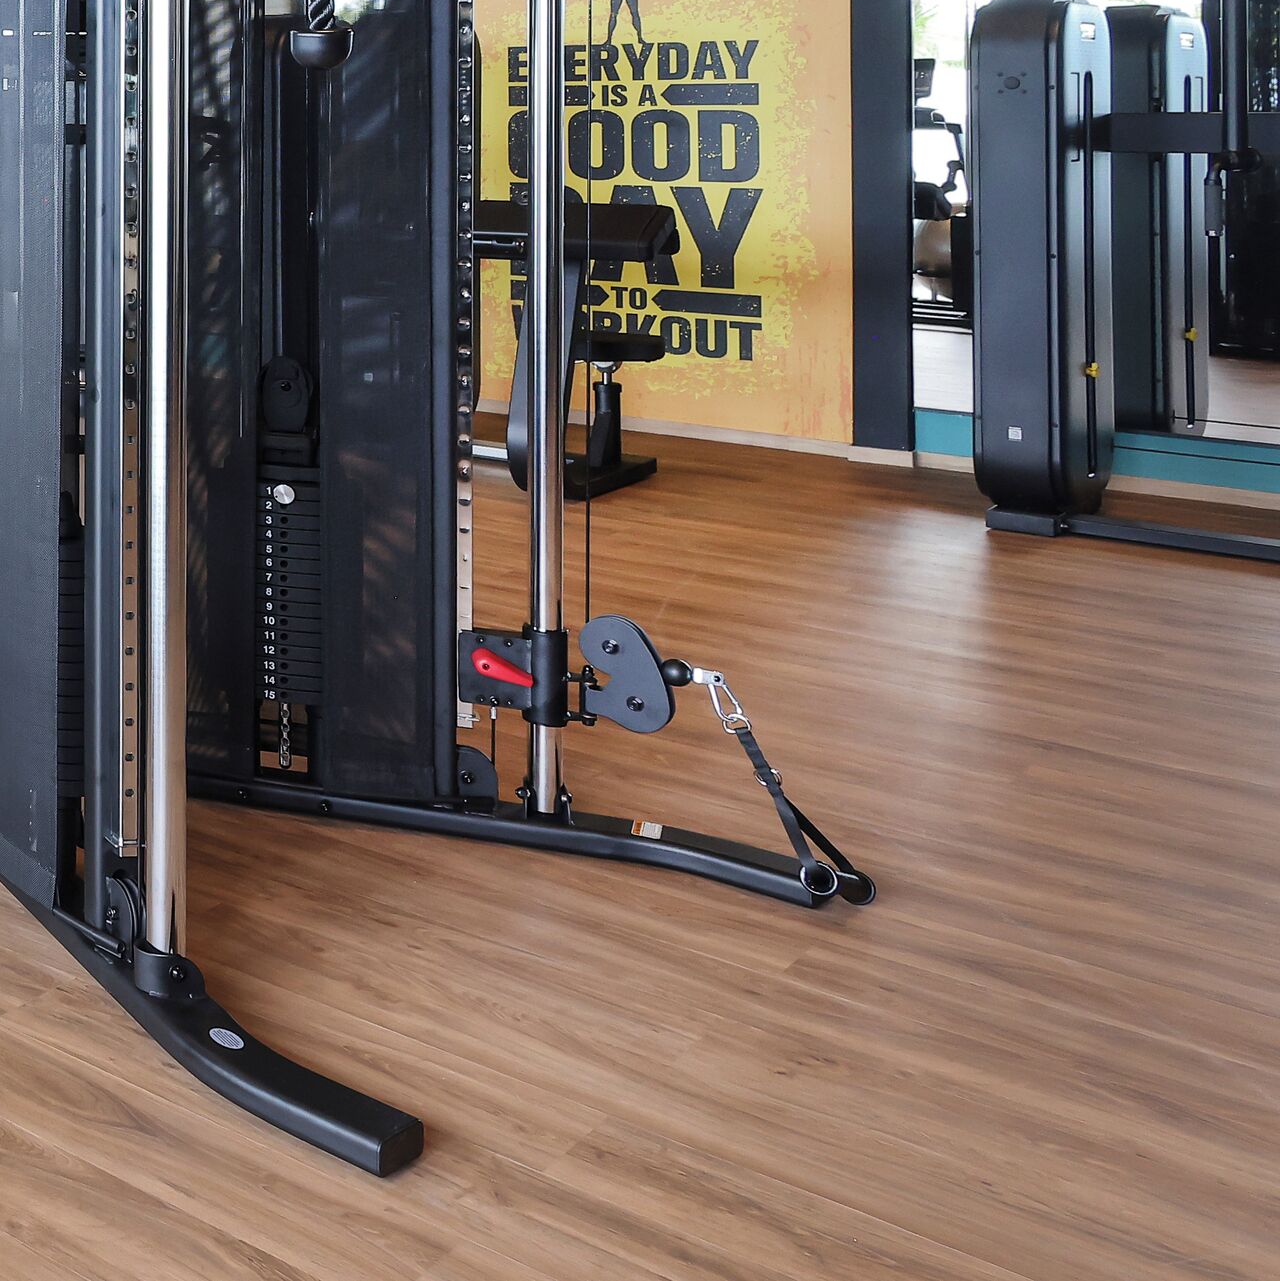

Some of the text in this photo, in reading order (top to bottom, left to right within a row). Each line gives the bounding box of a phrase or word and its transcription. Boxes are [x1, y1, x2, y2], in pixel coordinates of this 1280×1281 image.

[508, 39, 760, 82] EERYDAY
[601, 84, 658, 107] IS A
[610, 286, 648, 310] TO
[512, 303, 763, 361] RKOUT
[265, 486, 273, 495] 1
[265, 501, 273, 510] 2
[265, 516, 273, 524] 3
[265, 530, 273, 538] 4
[265, 545, 273, 553] 5
[265, 558, 273, 567] 6
[265, 573, 273, 581] 7
[265, 587, 273, 596] 8
[265, 602, 273, 611] 9
[263, 616, 275, 625] 10
[264, 631, 275, 640] 11
[263, 646, 275, 655] 12
[264, 661, 275, 670] 13
[264, 676, 275, 684] 14
[264, 690, 275, 699] 15
